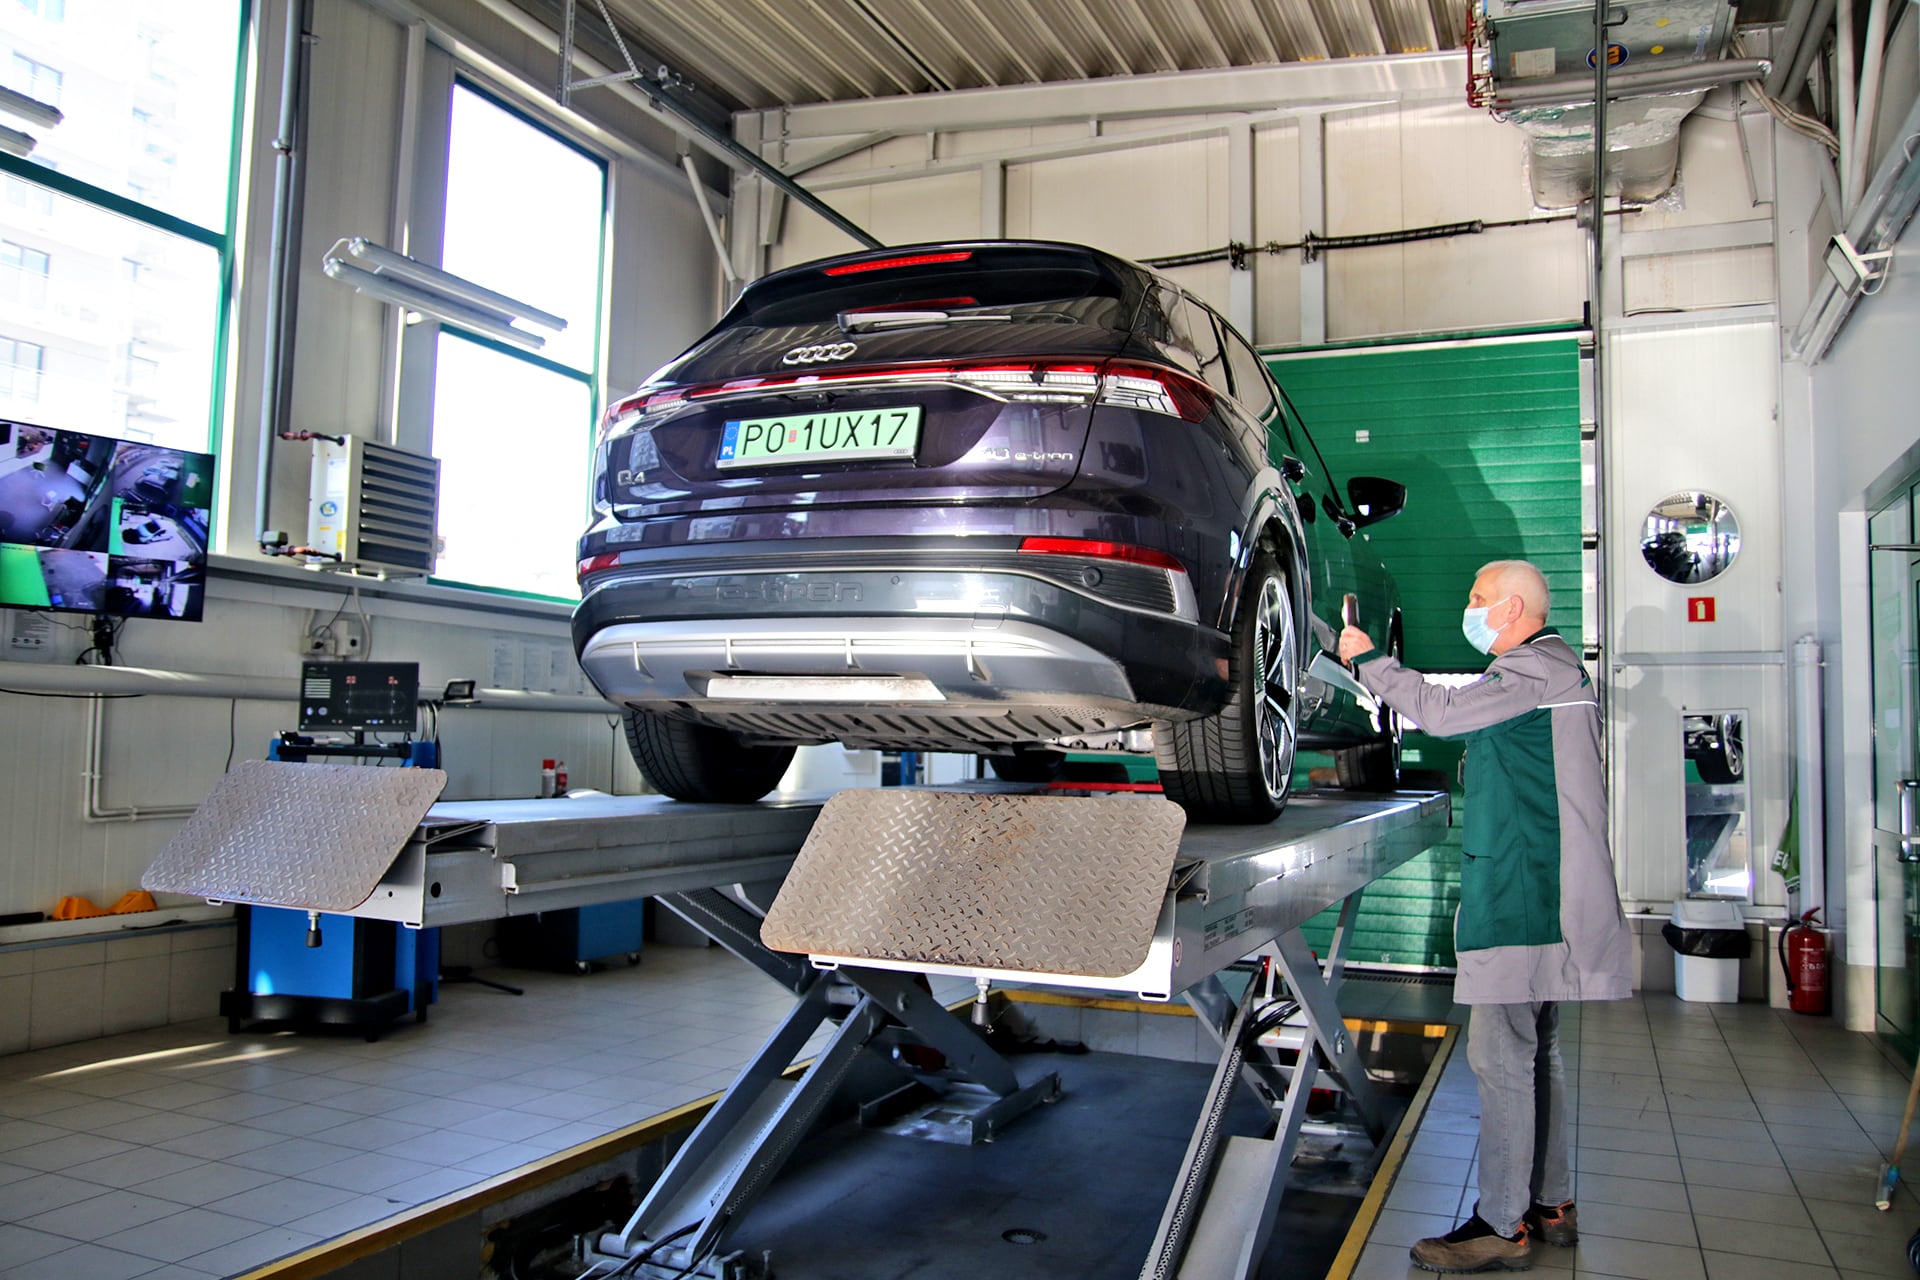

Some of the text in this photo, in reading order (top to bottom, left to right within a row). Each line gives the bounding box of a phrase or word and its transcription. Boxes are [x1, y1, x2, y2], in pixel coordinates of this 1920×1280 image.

[742, 412, 909, 456] PO 1UX17
[722, 446, 734, 456] PL
[617, 469, 646, 487] Q4
